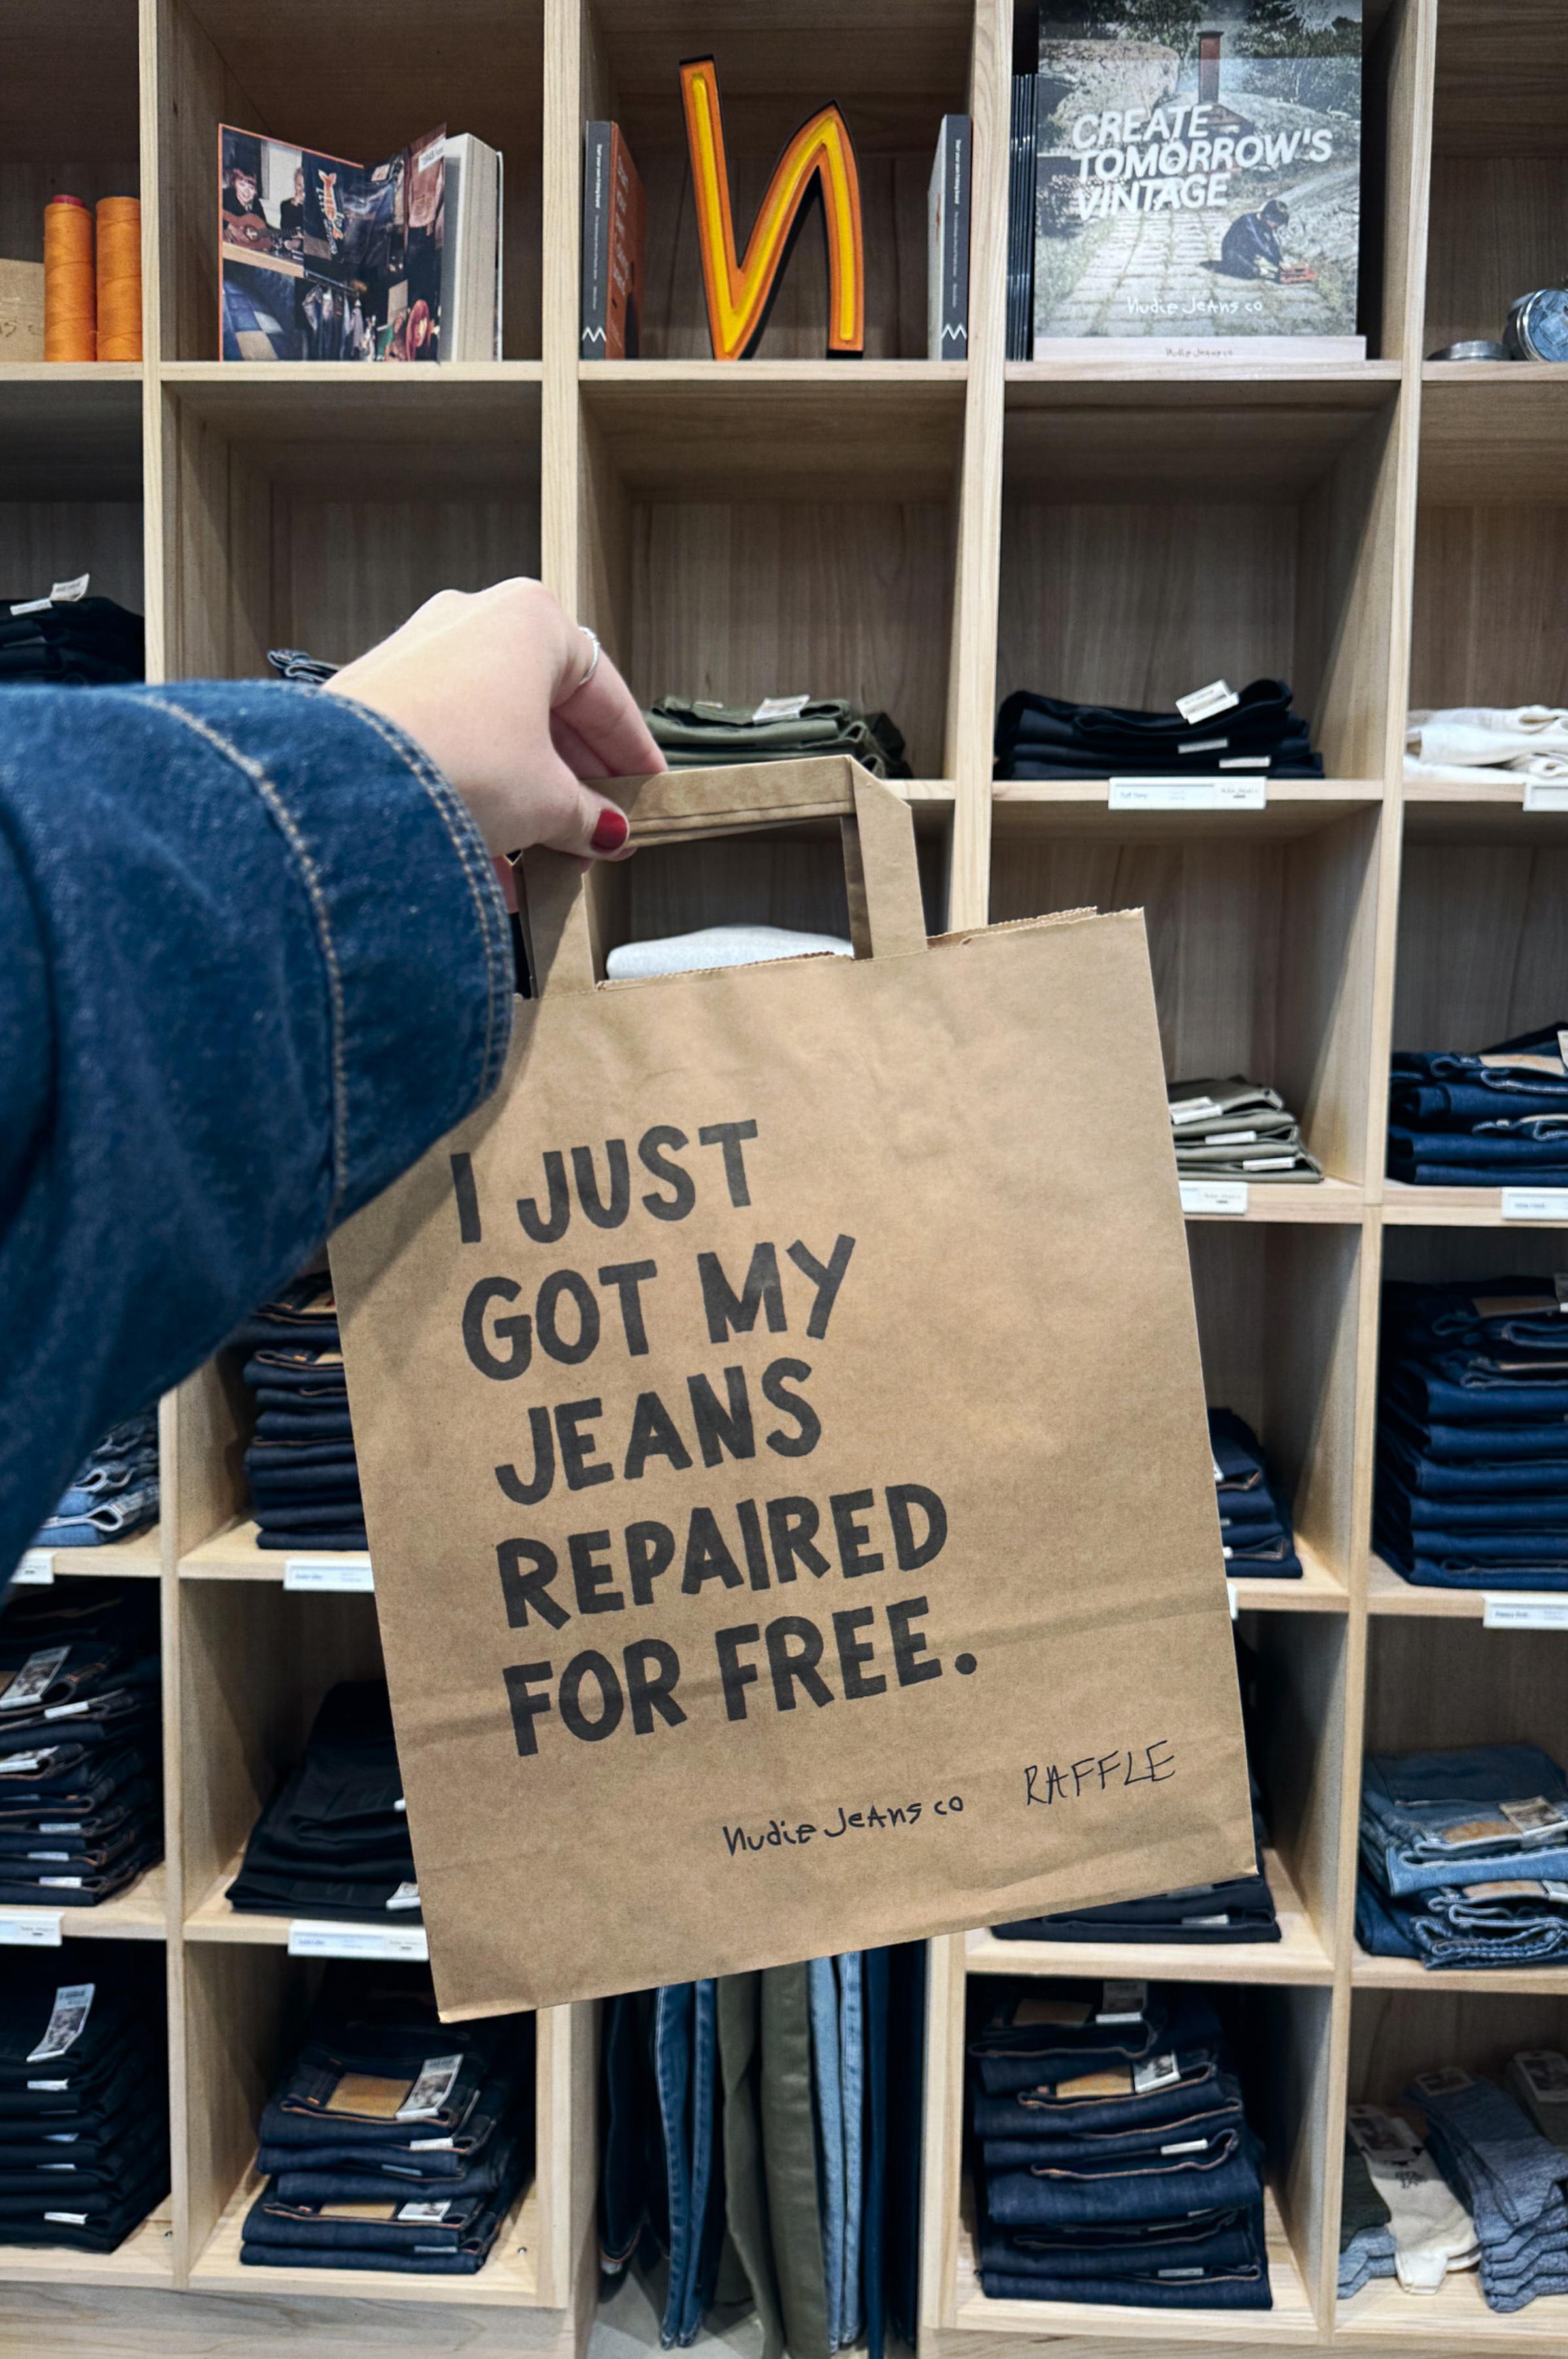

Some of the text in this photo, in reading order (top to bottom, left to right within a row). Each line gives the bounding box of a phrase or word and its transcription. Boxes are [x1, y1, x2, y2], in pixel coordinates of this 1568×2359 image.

[1070, 128, 1333, 184] TOMORROW'S
[1072, 105, 1213, 150] CREATE
[1077, 172, 1231, 221] VINTAGE
[1127, 296, 1178, 314] Nudie
[1245, 301, 1263, 312] co
[450, 1118, 759, 1244] I JUST
[462, 1233, 856, 1381] GOT MY
[495, 1357, 822, 1505] JEANS
[496, 1483, 947, 1629] REPAIRED
[502, 1596, 977, 1757] FOR FREE.
[1024, 1740, 1176, 1806] RAFFLE
[723, 1819, 817, 1857] Nudie
[934, 1796, 964, 1816] co
